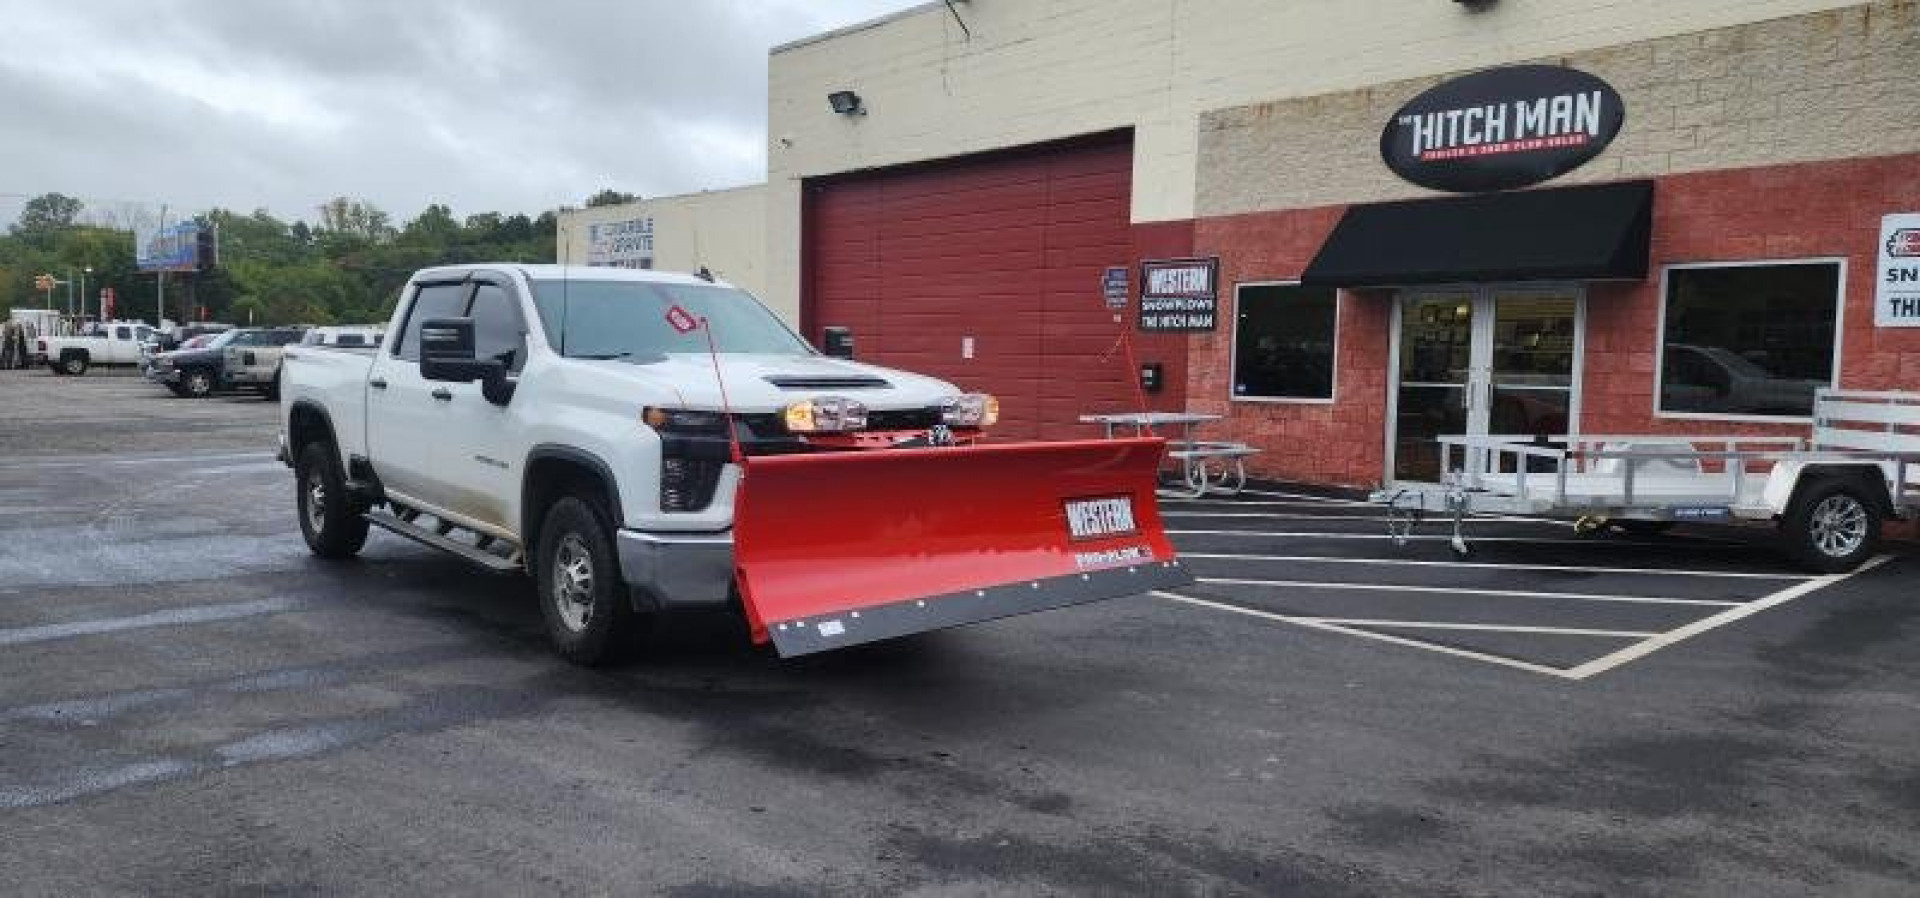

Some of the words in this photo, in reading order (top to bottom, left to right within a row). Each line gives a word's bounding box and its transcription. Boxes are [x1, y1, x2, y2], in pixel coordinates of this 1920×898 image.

[1413, 103, 1507, 156] HITCH
[1514, 91, 1602, 136] MAN
[1150, 266, 1208, 294] WESTERN
[1066, 498, 1135, 535] WESTERN
